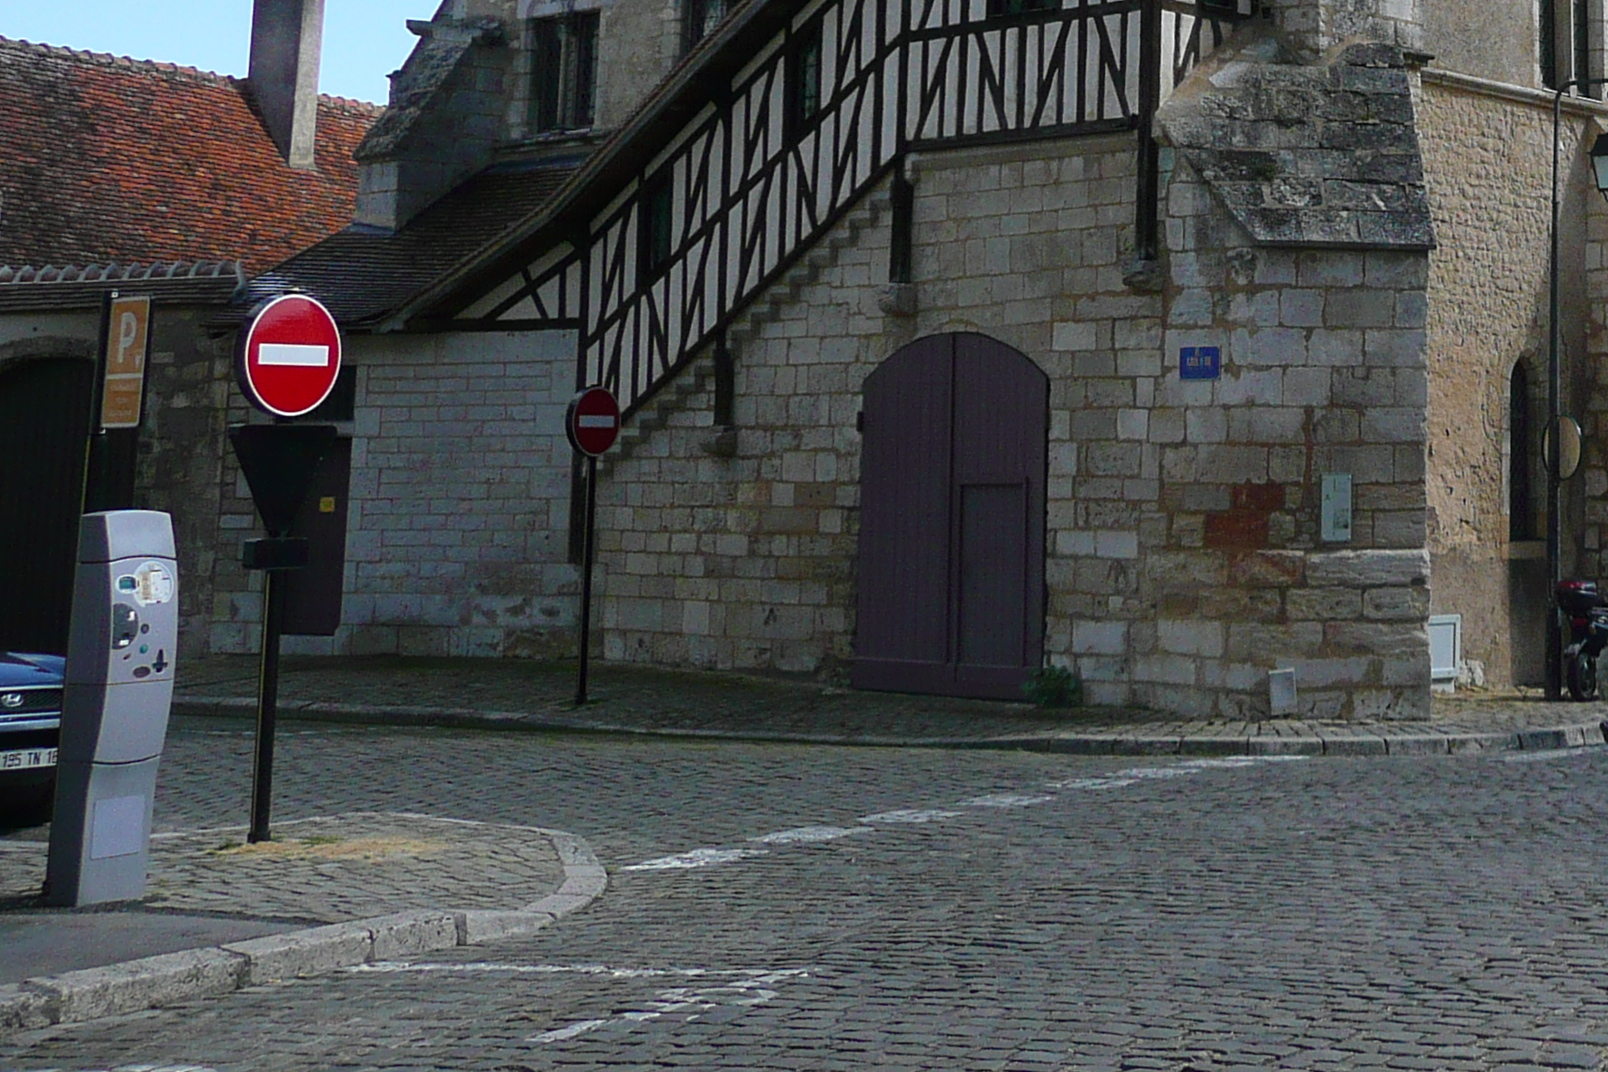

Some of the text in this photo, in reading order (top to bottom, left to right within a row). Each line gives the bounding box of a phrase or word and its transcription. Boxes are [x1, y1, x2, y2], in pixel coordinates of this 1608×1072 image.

[117, 311, 137, 364] P
[0, 753, 22, 768] 195
[28, 751, 41, 766] TN
